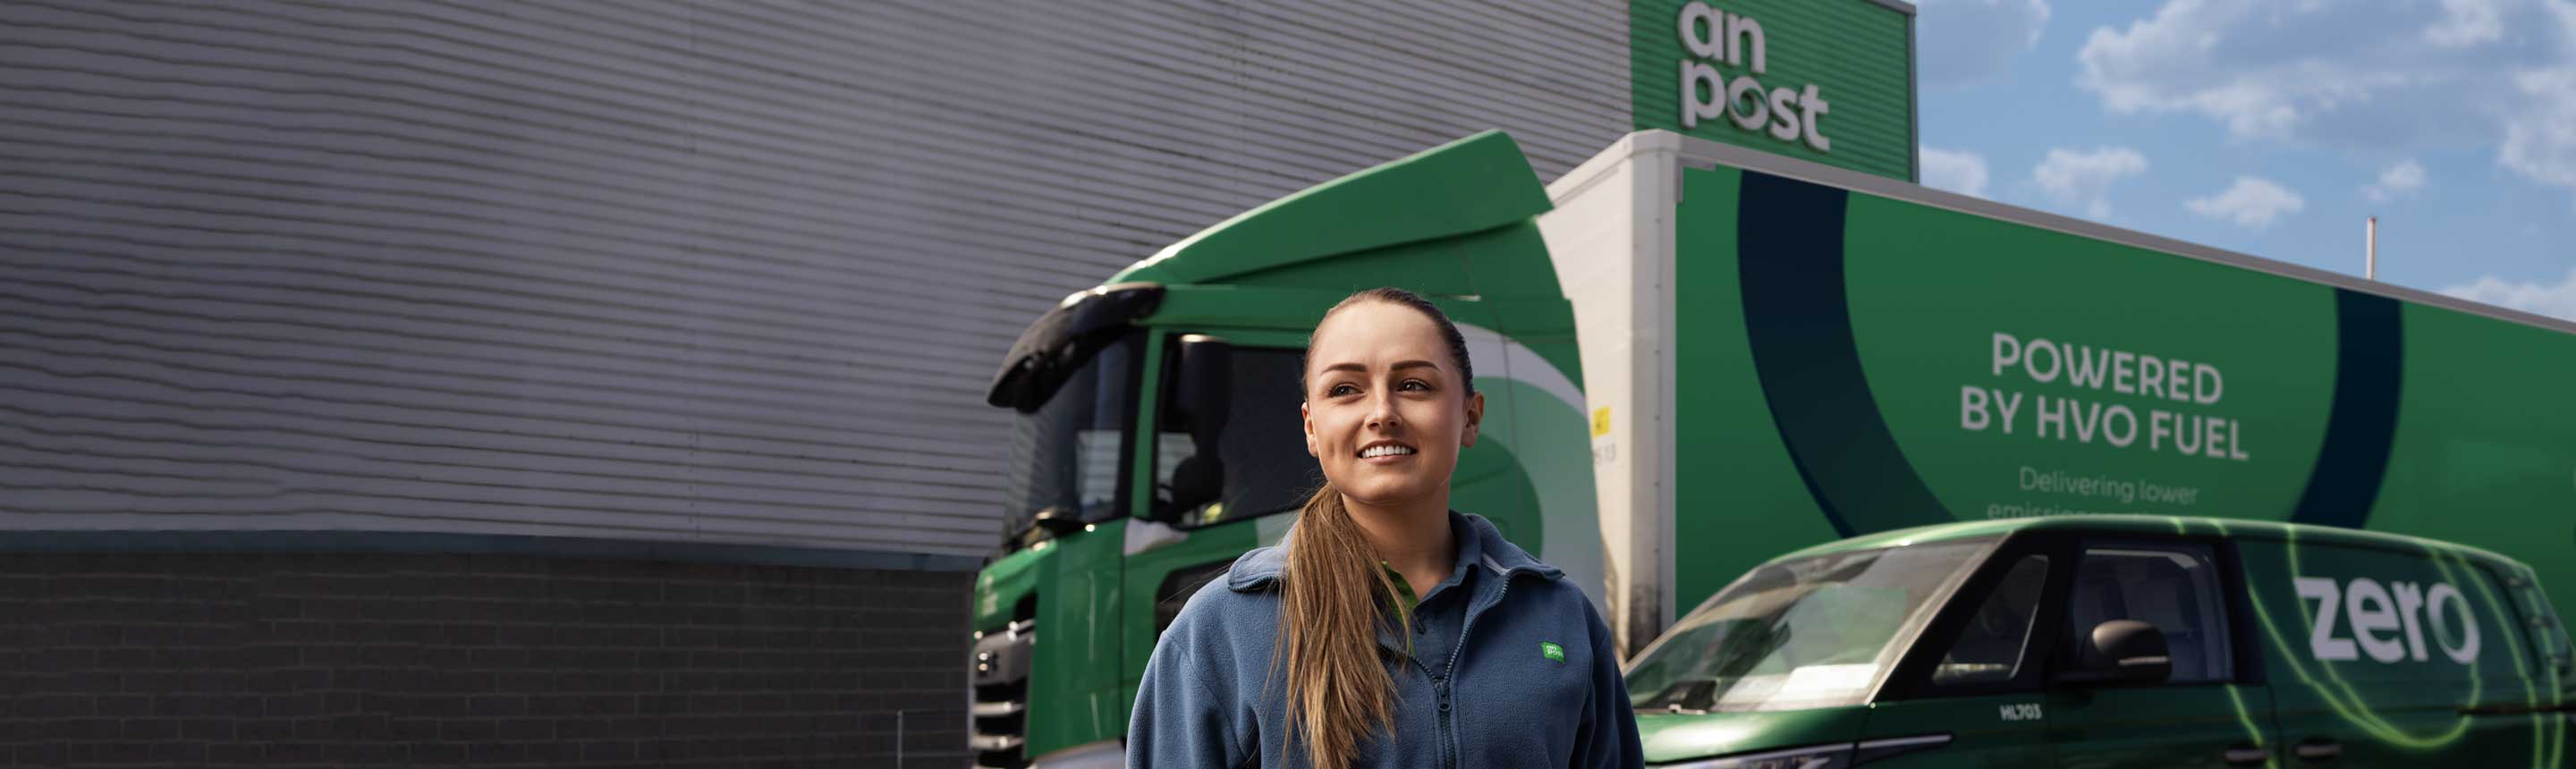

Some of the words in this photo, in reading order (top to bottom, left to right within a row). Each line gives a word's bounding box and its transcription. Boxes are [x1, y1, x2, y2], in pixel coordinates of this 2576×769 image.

[1679, 1, 1766, 73] an
[1680, 59, 1831, 151] post
[1992, 332, 2224, 404] POWERED
[1961, 385, 2022, 435] BY
[2037, 395, 2139, 447] HVO
[2149, 410, 2250, 461] FUEL
[2019, 466, 2135, 503] Delivering
[2139, 478, 2199, 505] lower
[2293, 577, 2481, 664] zero
[1999, 703, 2043, 721] HL703
